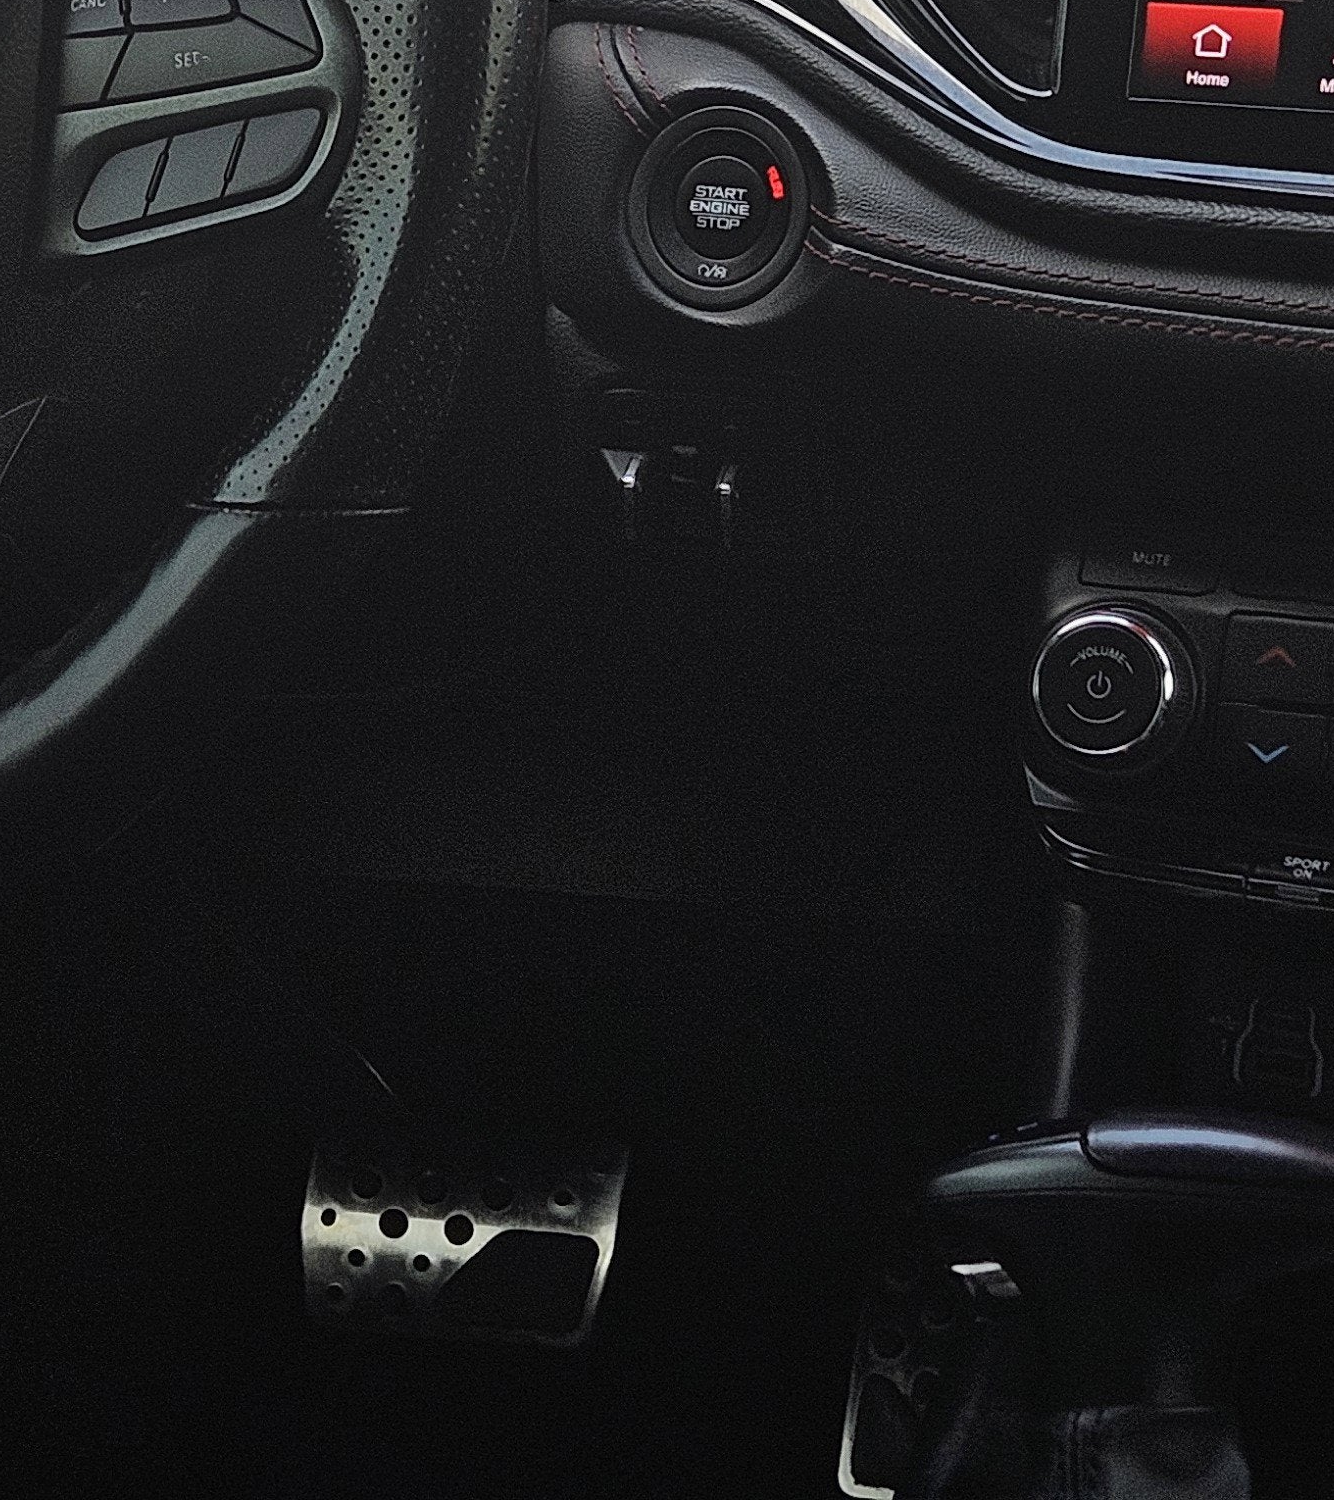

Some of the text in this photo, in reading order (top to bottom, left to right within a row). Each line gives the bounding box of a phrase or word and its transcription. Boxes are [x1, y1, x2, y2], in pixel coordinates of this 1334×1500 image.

[1185, 70, 1230, 88] Home
[695, 185, 749, 199] START
[689, 200, 750, 216] ENGINE
[695, 216, 740, 230] STOP
[1132, 552, 1172, 567] MUTE
[1284, 856, 1330, 871] SPORT
[1293, 868, 1313, 880] ON
